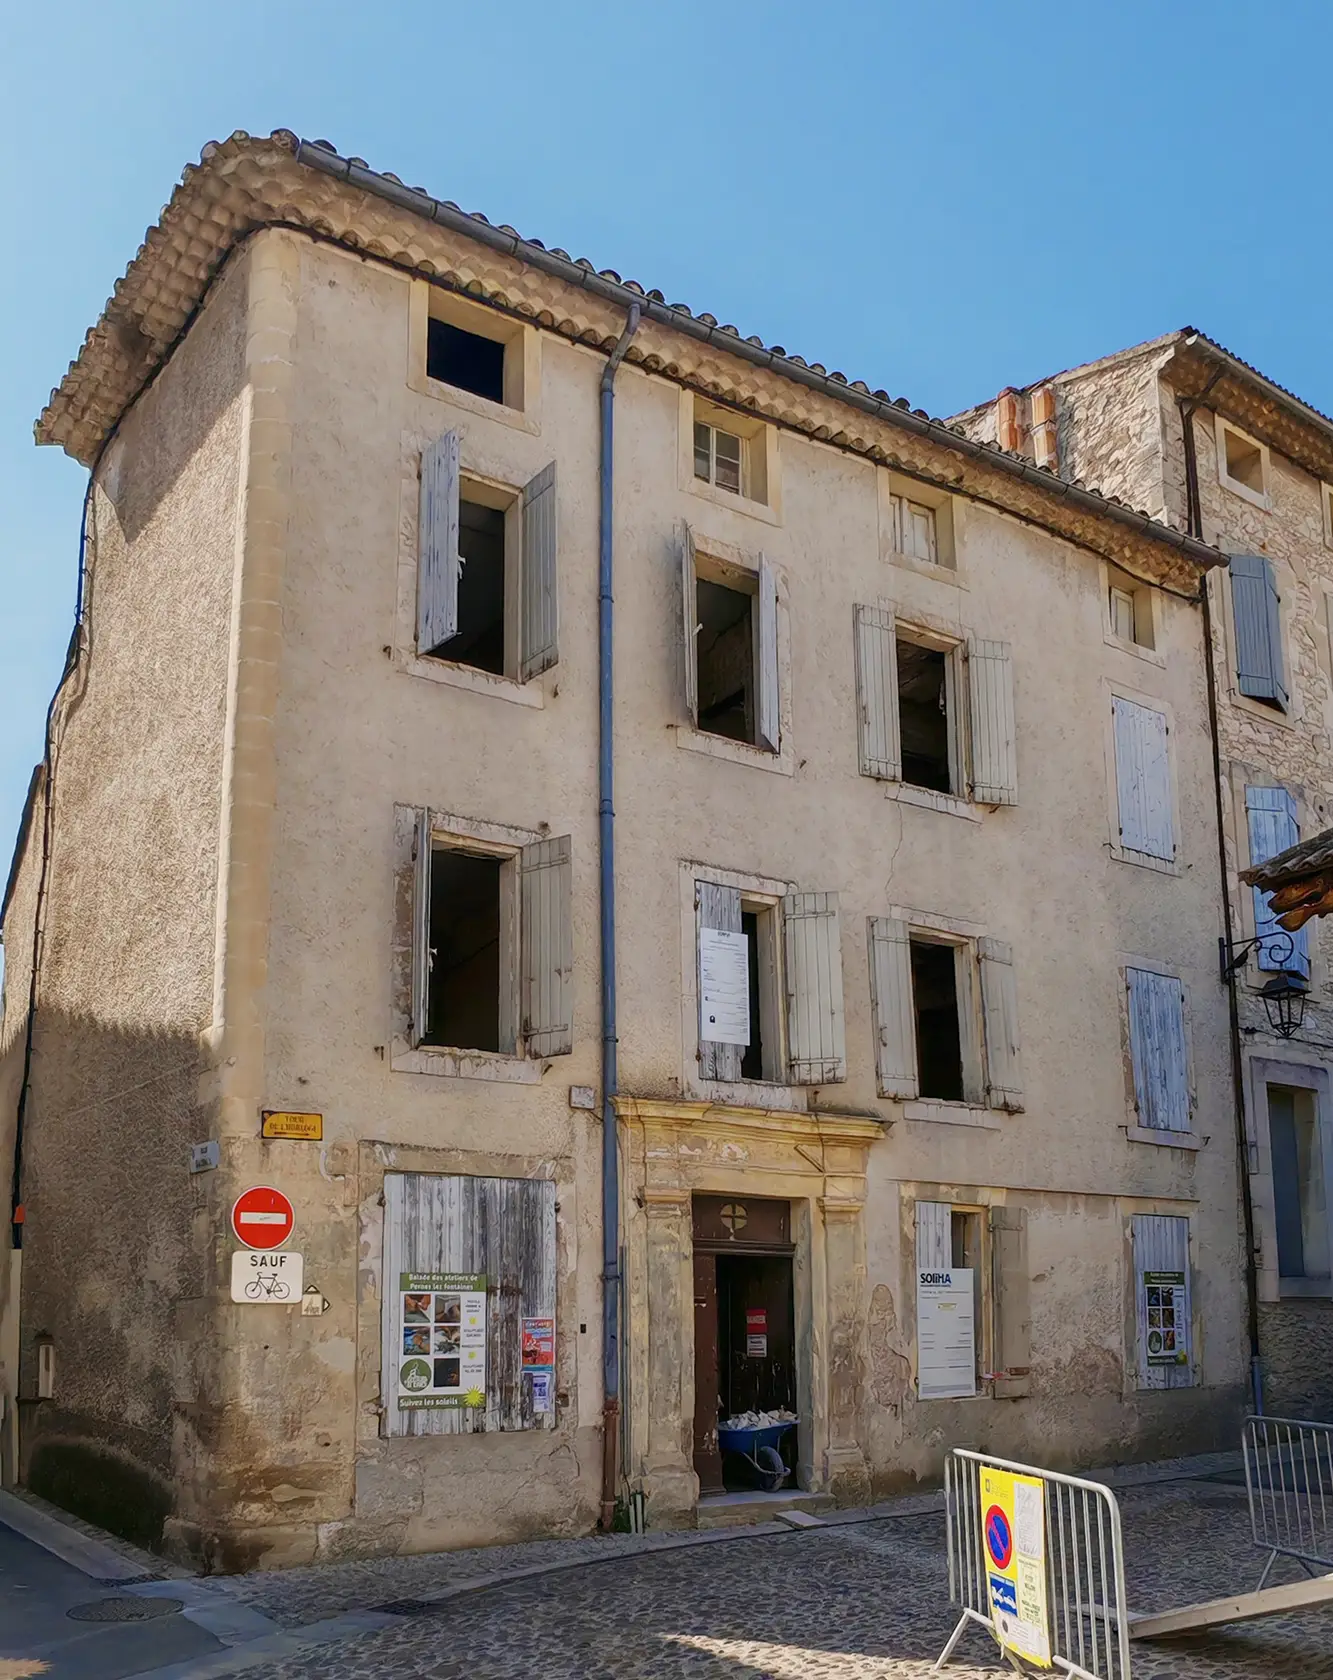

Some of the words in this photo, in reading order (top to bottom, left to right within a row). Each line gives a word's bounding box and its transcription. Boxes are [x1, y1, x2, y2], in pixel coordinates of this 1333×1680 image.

[250, 1254, 287, 1267] SAUF
[409, 1273, 430, 1281] Balade
[432, 1273, 443, 1281] des
[470, 1274, 478, 1282] de
[399, 1398, 423, 1407] Suivez
[424, 1398, 434, 1406] les
[435, 1397, 458, 1406] soleils
